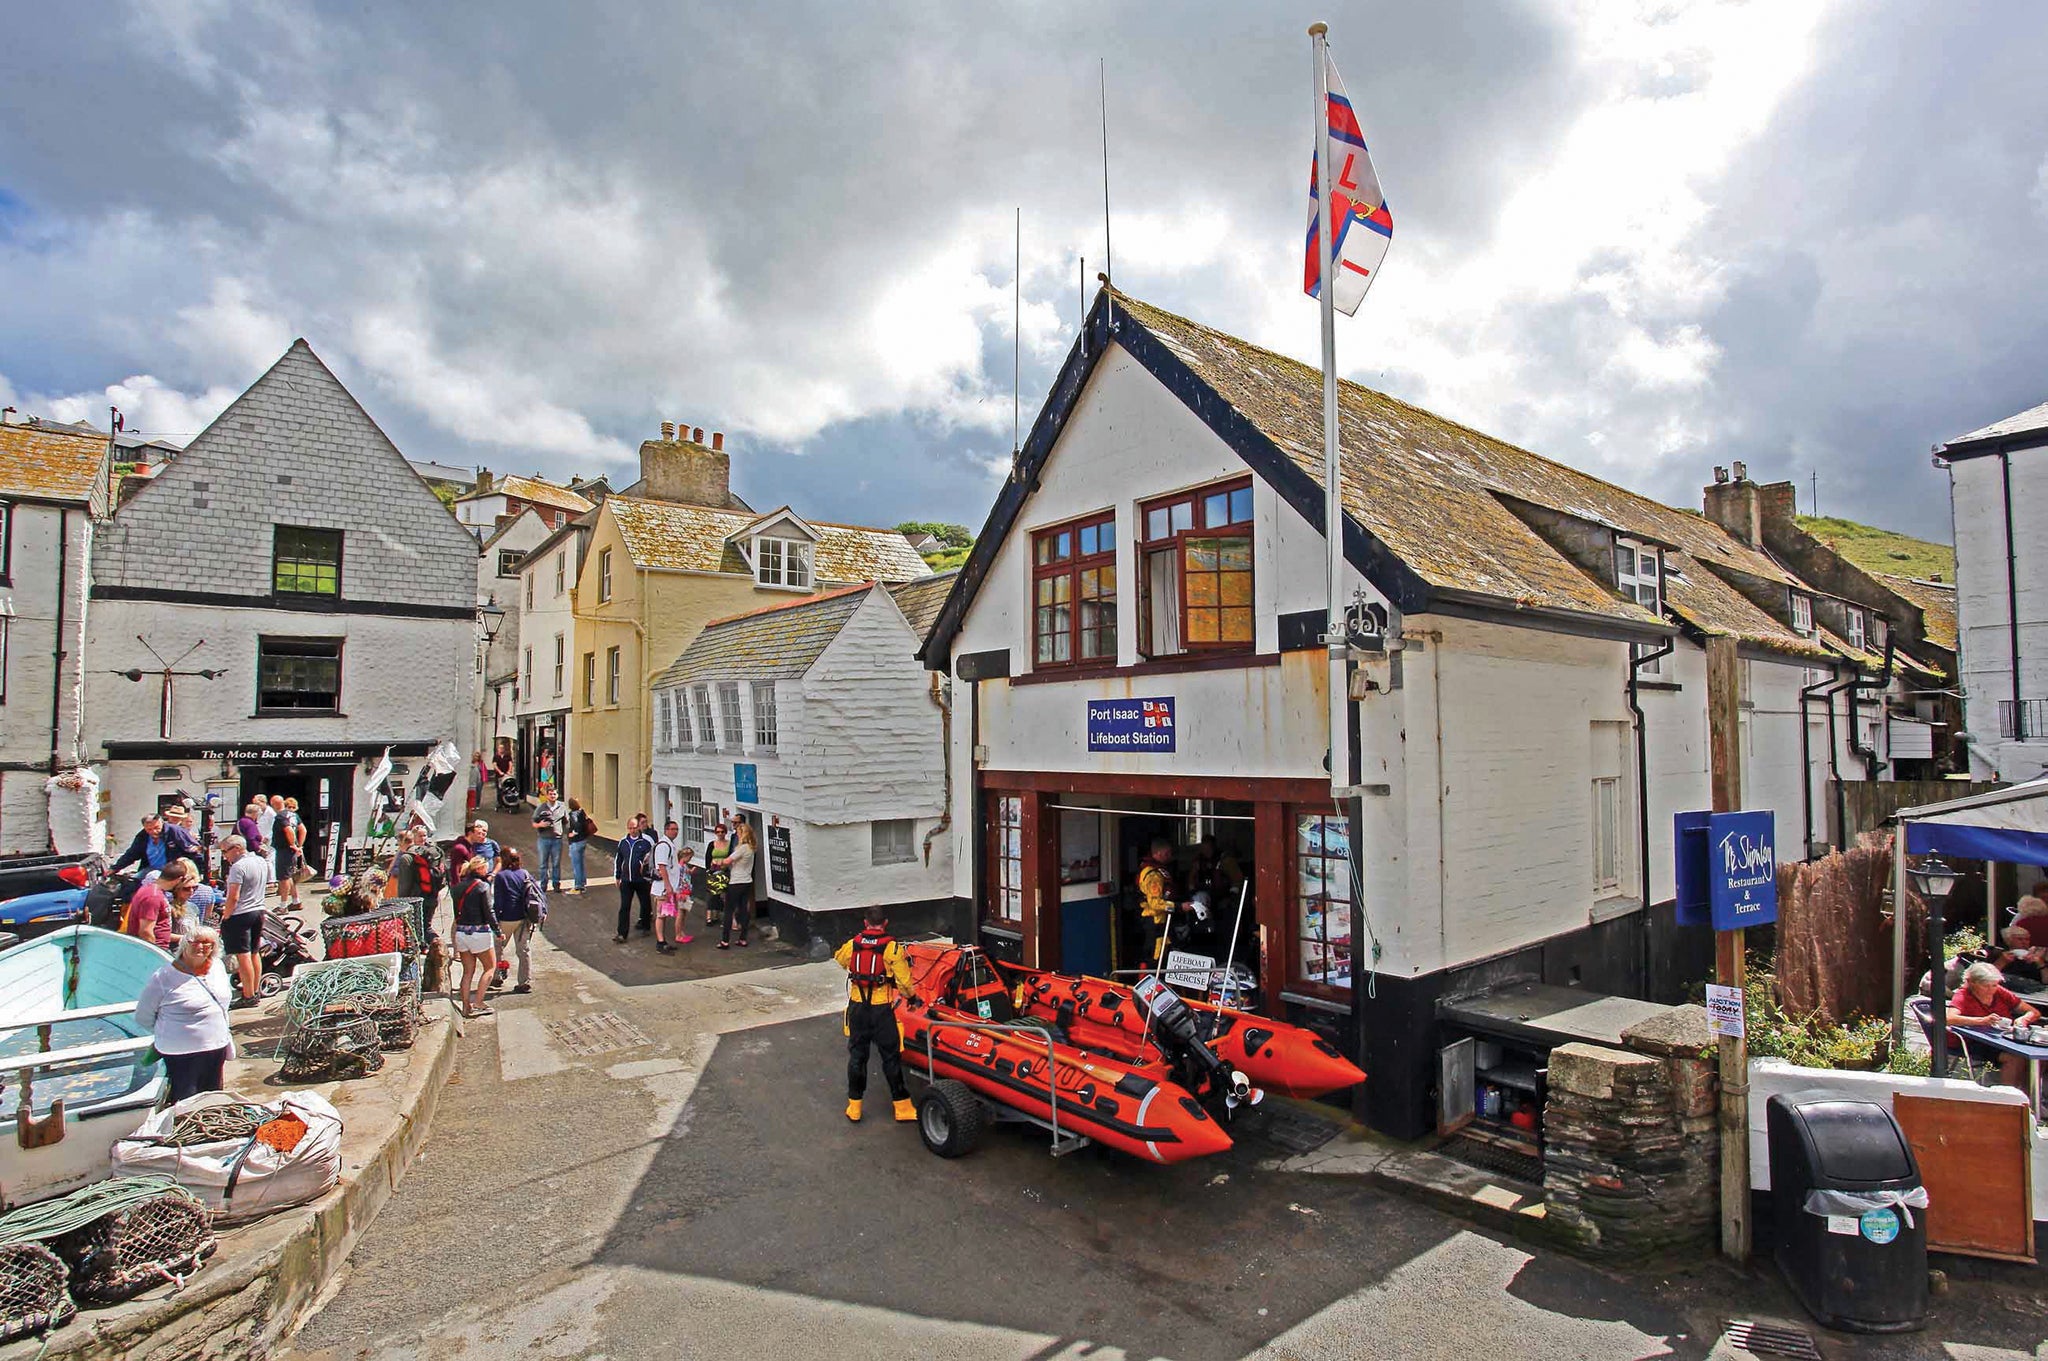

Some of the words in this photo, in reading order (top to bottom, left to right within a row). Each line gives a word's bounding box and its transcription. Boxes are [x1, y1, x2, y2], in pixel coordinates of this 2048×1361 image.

[1090, 709, 1111, 720] Port
[1113, 708, 1139, 720] Isaac
[1090, 732, 1130, 744] Lifeboat
[1132, 731, 1170, 744] Station
[201, 750, 224, 759] The
[226, 750, 258, 759] Mote
[261, 750, 281, 759] Bar
[283, 750, 293, 759] &
[296, 749, 354, 758] Restaurant
[1728, 876, 1766, 889] Restaurant
[1743, 890, 1751, 901] &
[1734, 902, 1761, 915] Terrace
[1172, 955, 1206, 968] LIFEBOAT
[1167, 971, 1206, 986] EXERCISE
[1708, 997, 1741, 1007] AUCTION
[1711, 1003, 1739, 1014] TODAY
